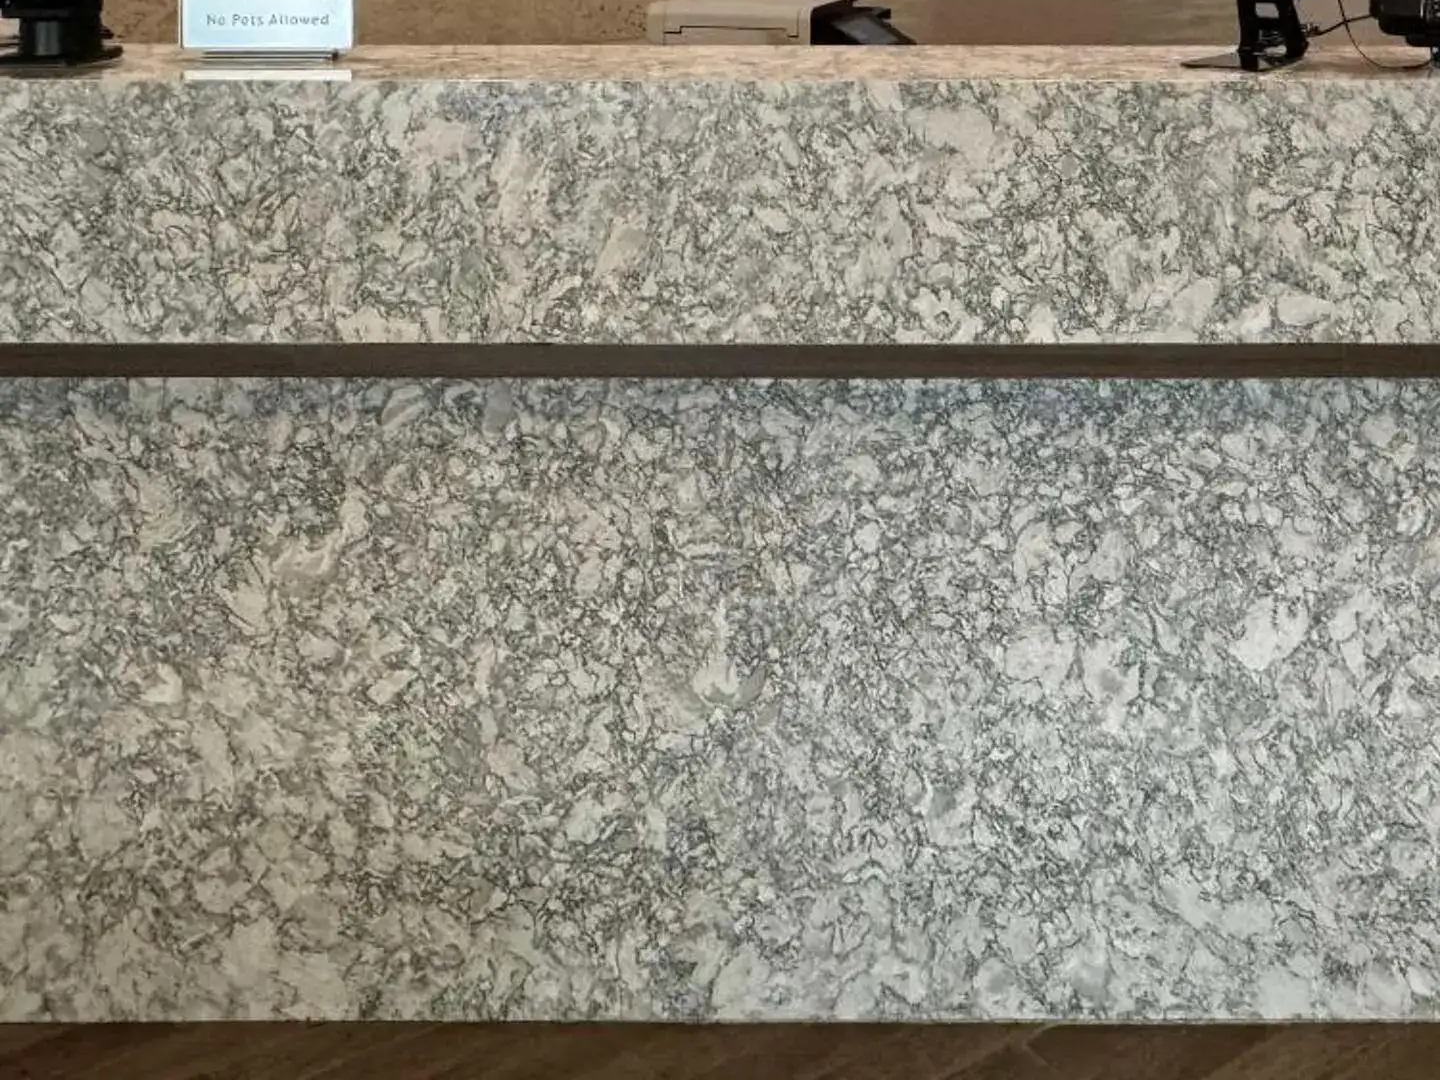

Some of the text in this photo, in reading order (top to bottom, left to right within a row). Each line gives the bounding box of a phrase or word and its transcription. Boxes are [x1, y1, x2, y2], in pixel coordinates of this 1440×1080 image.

[206, 13, 330, 27] No Pets Allowed
